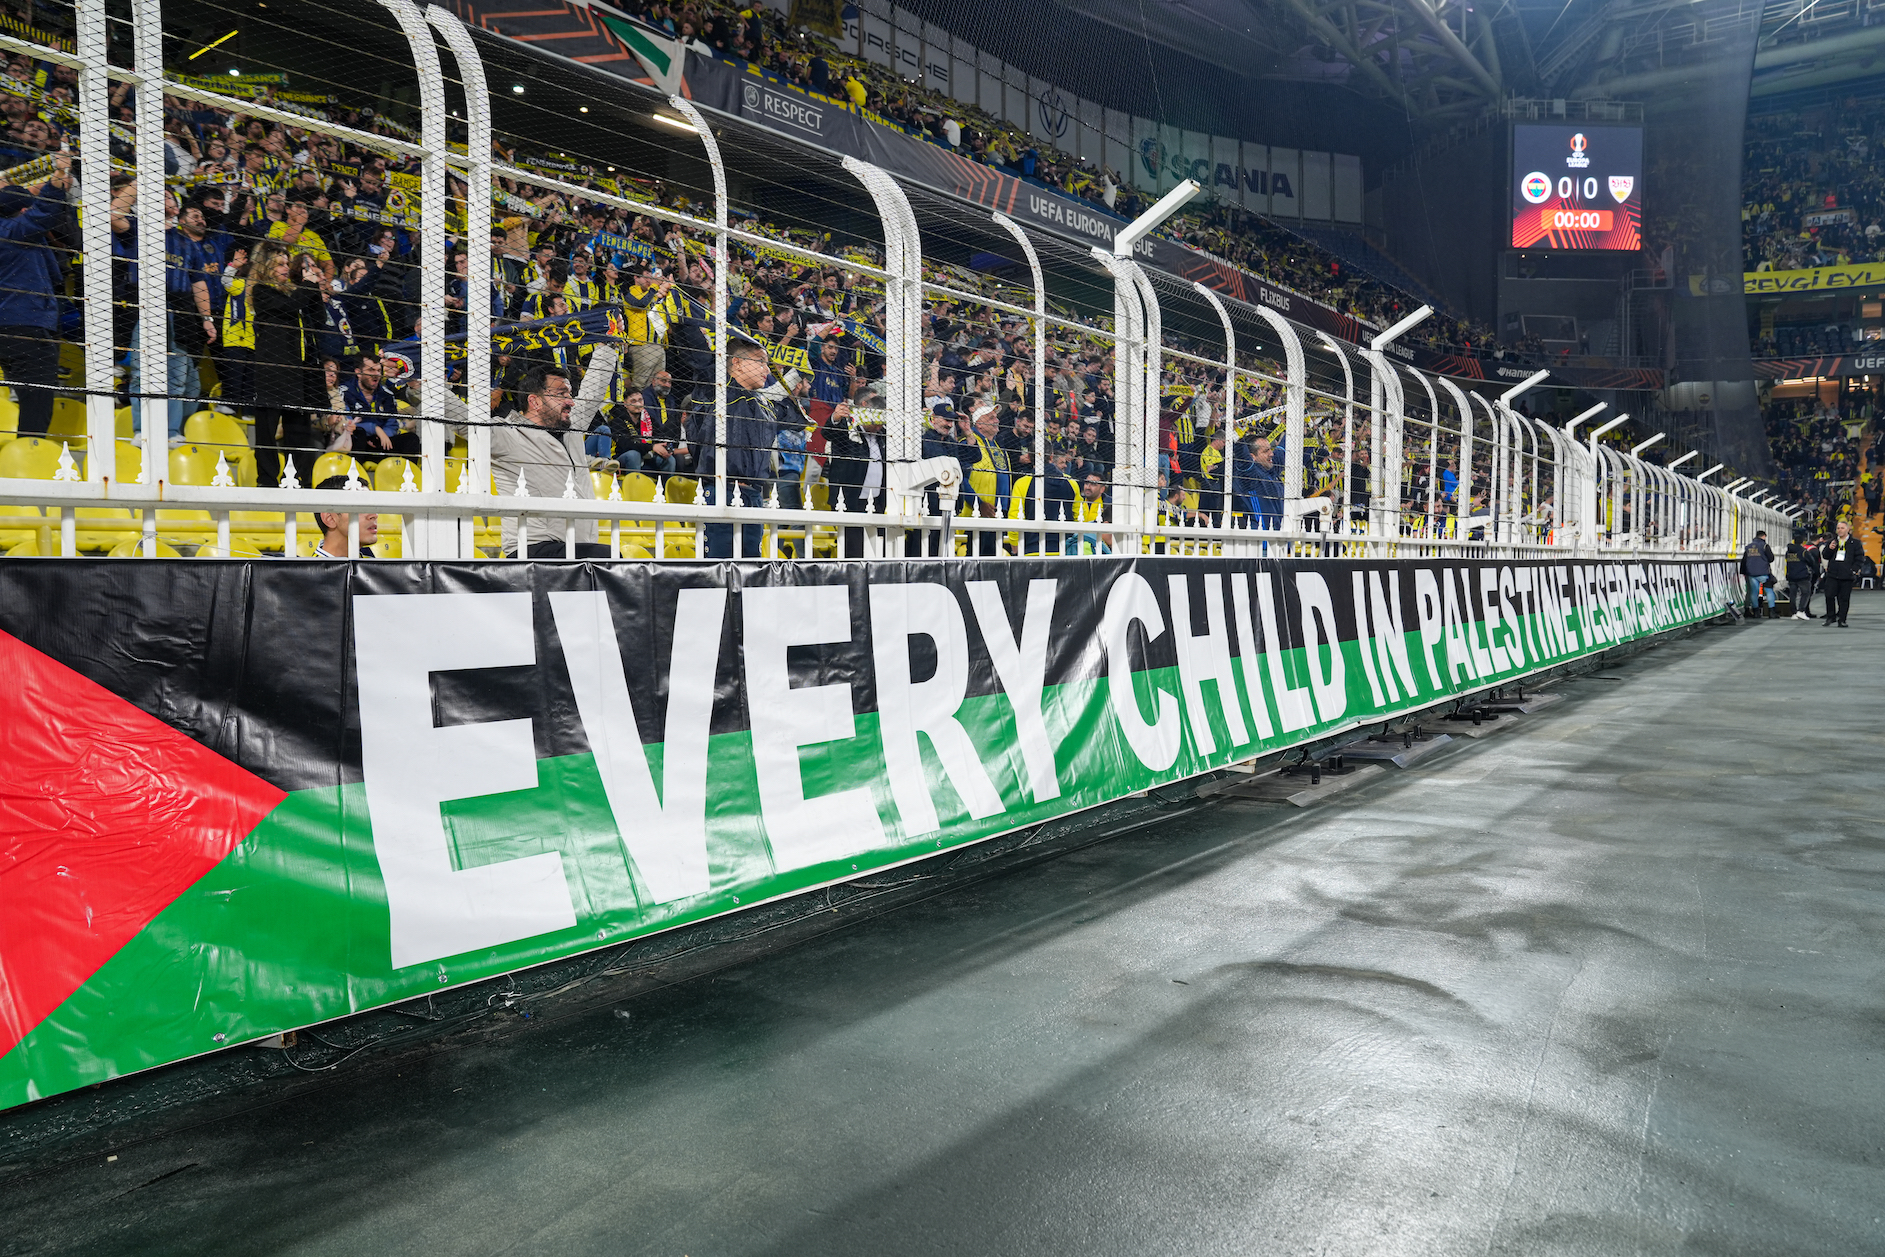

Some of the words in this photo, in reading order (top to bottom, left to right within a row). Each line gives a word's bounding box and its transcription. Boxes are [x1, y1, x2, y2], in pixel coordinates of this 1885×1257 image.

[842, 21, 948, 82] PORSCHE
[764, 94, 823, 130] RESPECT
[1171, 154, 1294, 198] SCANIA
[1030, 194, 1064, 224] UEFA
[1066, 208, 1112, 243] EUROPA
[1554, 211, 1600, 228] 00:00
[1826, 271, 1885, 287] EYL
[1854, 357, 1885, 369] UEF
[353, 578, 1058, 970] EVERY
[1106, 571, 1348, 772] CHILD
[1352, 570, 1419, 708] IN
[1415, 566, 1579, 691] PALESTINE
[1573, 563, 1654, 646] DESERVES
